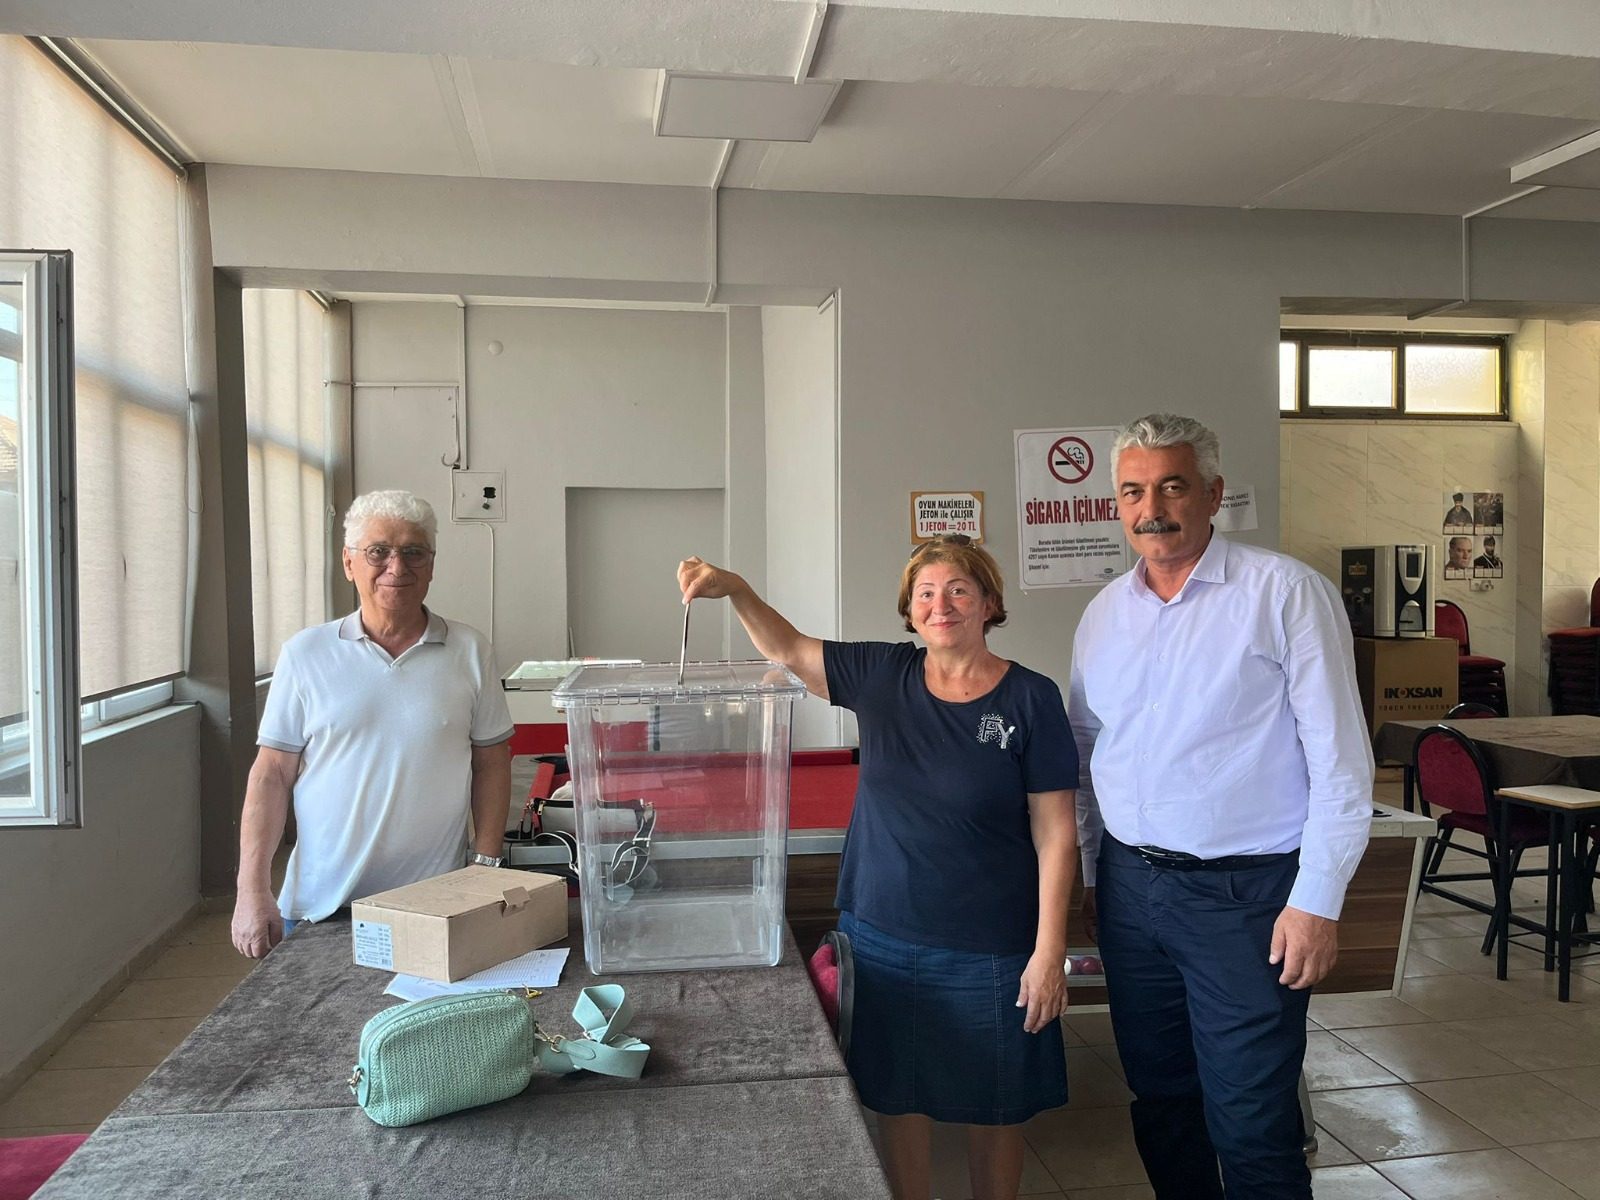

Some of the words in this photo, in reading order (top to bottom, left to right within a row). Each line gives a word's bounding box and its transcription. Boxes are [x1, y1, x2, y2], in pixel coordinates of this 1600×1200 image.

[918, 500, 937, 509] OYUN
[938, 498, 975, 509] MAKİNELERİ
[920, 510, 939, 520] JETON
[940, 510, 949, 519] ile
[950, 509, 974, 520] ÇALIŞIR
[1026, 498, 1071, 525] SİGARA
[920, 522, 924, 532] 1
[926, 521, 947, 532] JETON
[957, 521, 967, 531] 20
[968, 521, 977, 531] TL
